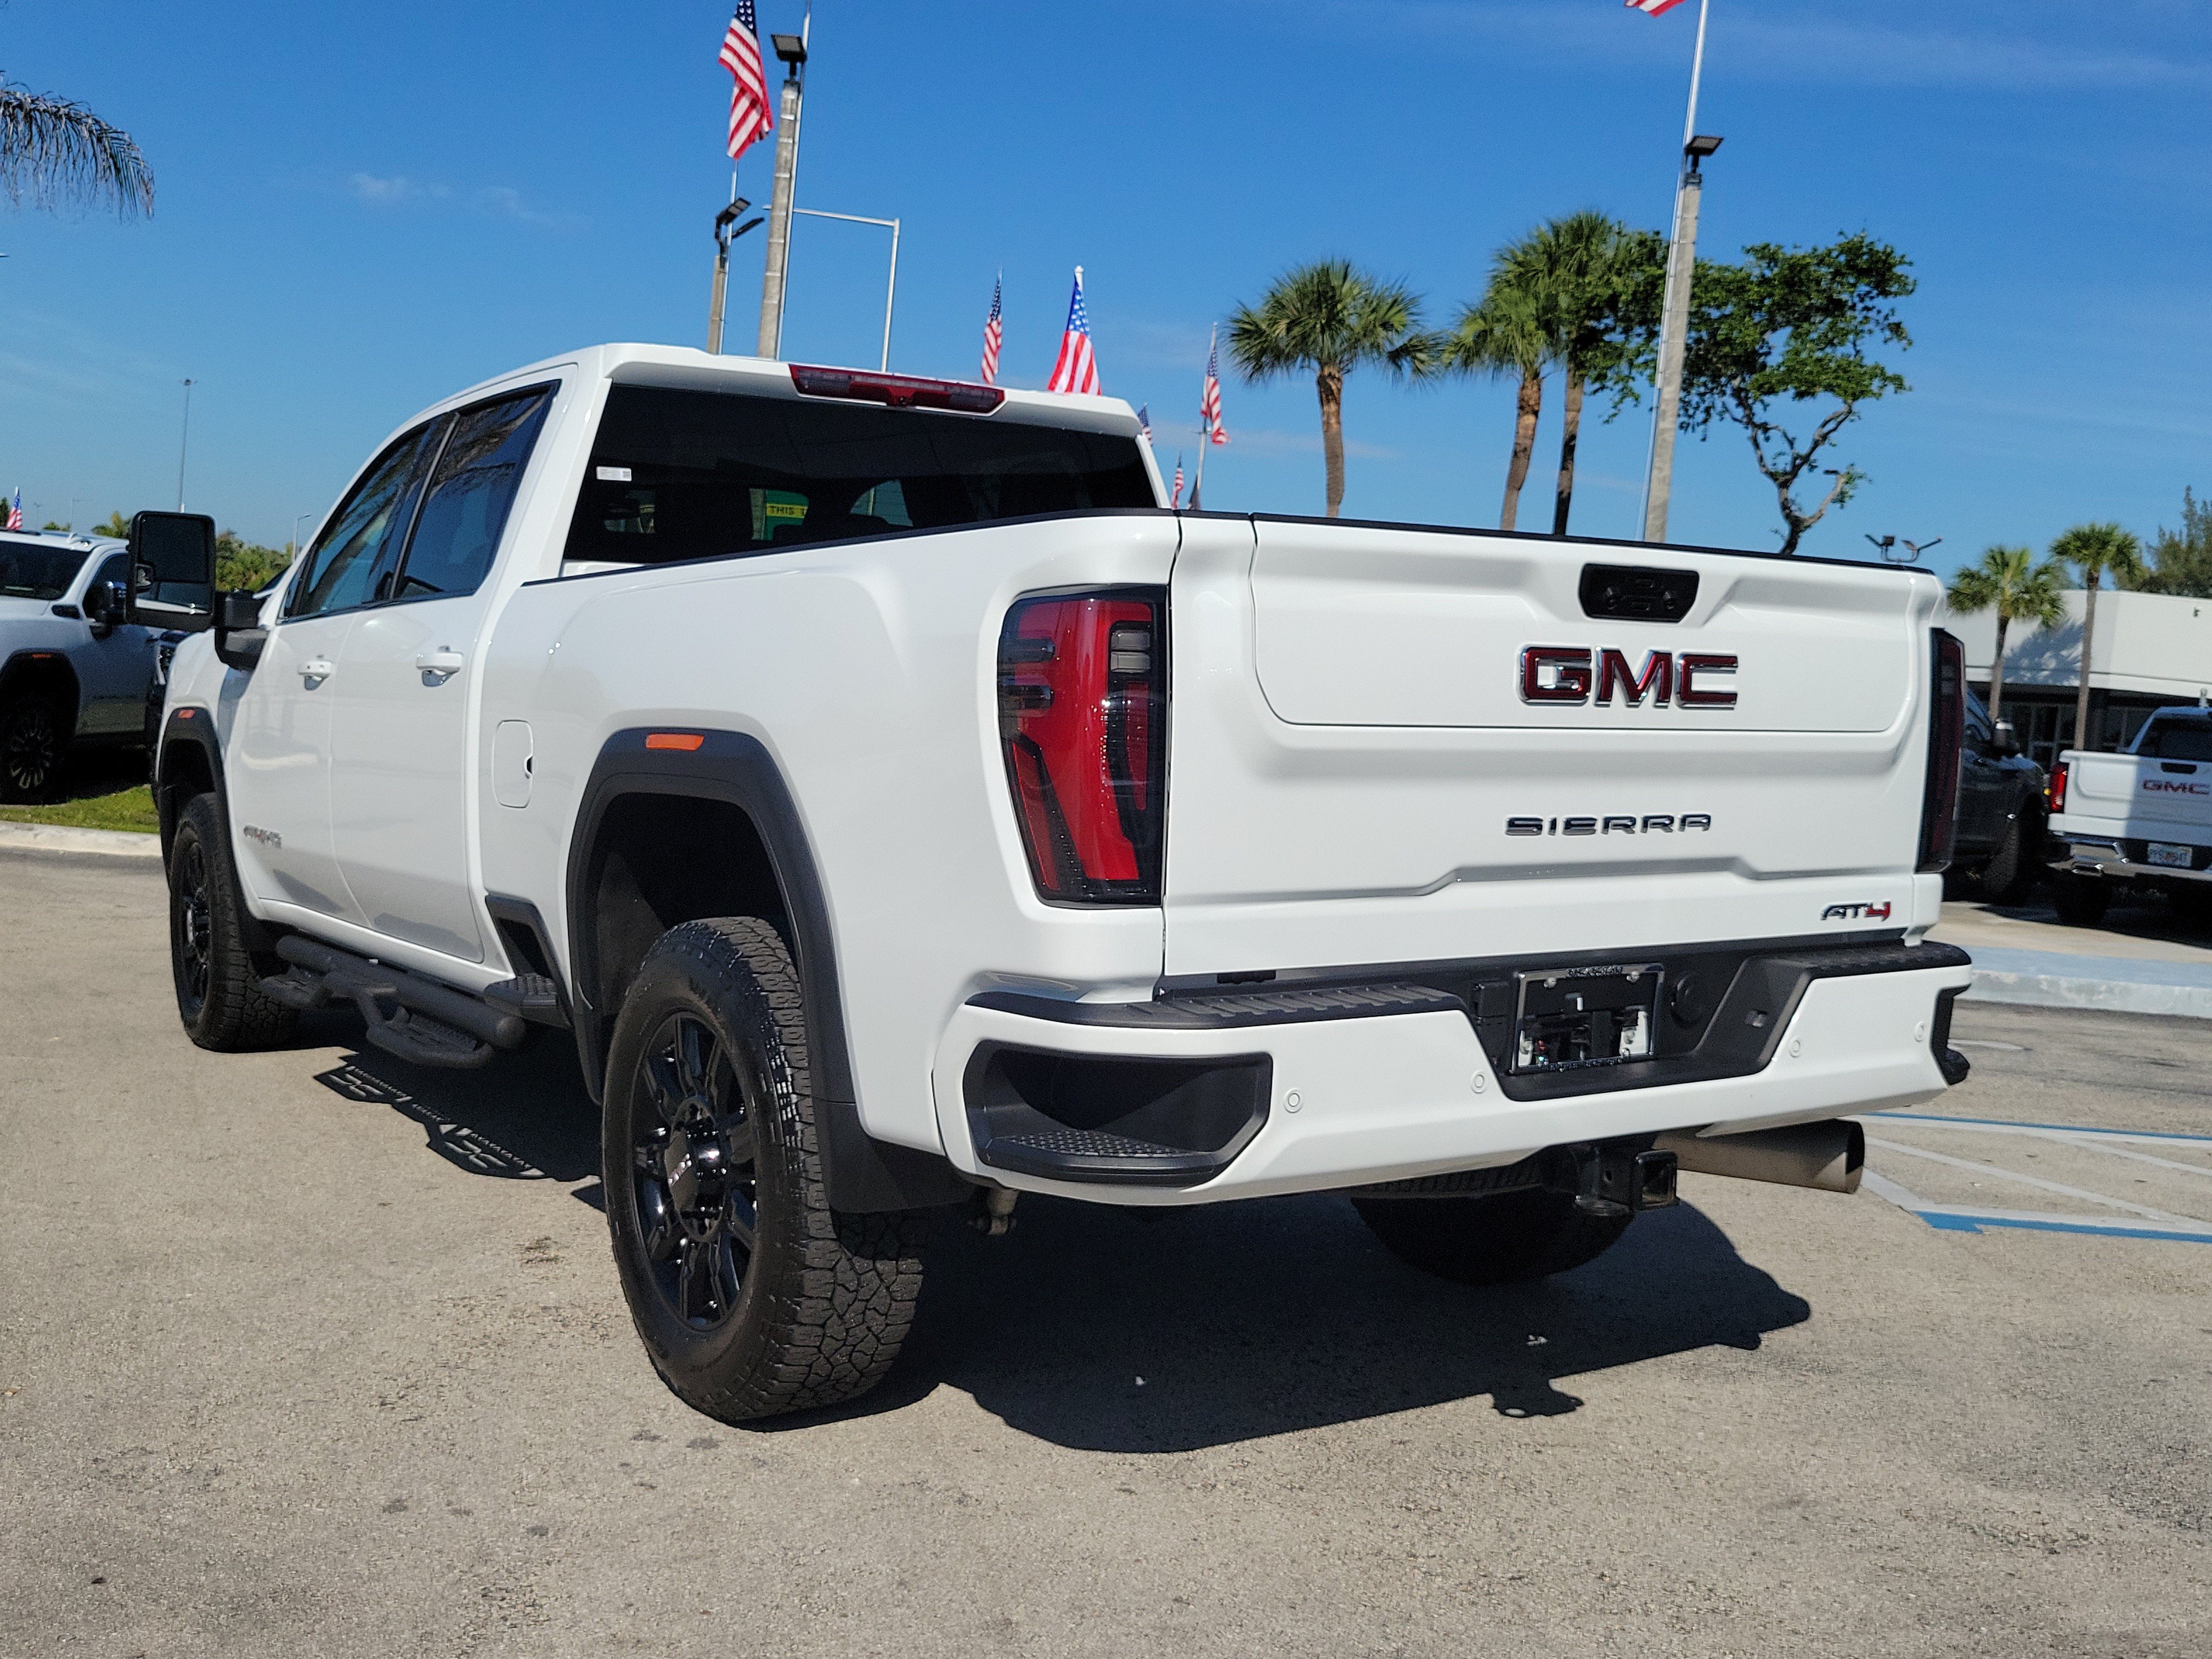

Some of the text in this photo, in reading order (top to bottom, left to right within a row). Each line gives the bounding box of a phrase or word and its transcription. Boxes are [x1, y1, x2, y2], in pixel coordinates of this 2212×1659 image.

[1519, 646, 1738, 710] GMC
[2143, 780, 2210, 795] GMC
[1505, 814, 1712, 836] SIERRA
[1821, 901, 1891, 922] AT4
